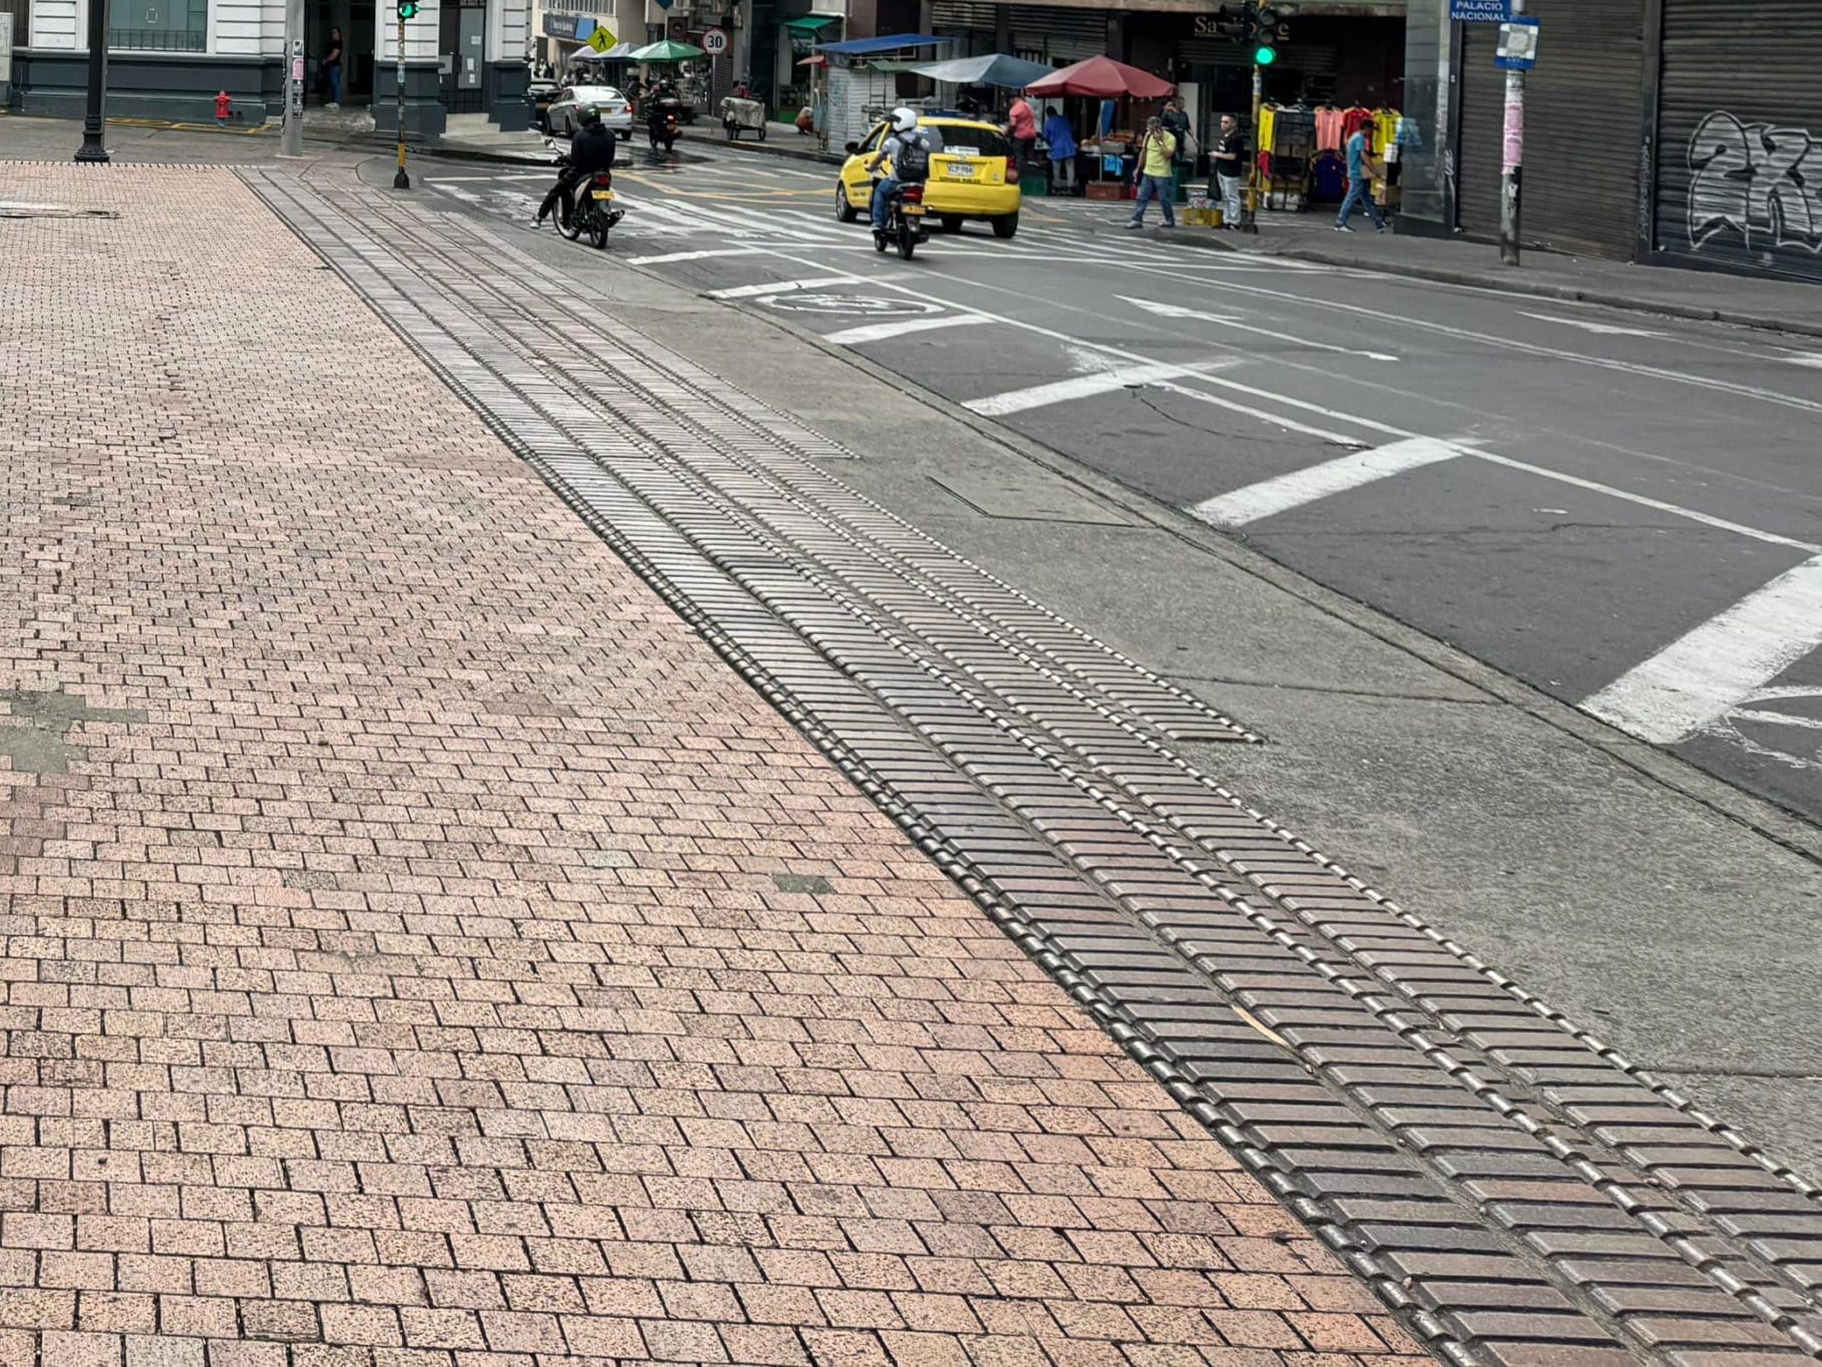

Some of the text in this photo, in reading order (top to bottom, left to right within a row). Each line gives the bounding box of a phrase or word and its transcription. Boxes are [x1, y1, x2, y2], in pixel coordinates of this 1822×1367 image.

[1456, 0, 1504, 12] PALACIO
[1450, 11, 1507, 22] NACIONAL
[707, 35, 723, 49] 30
